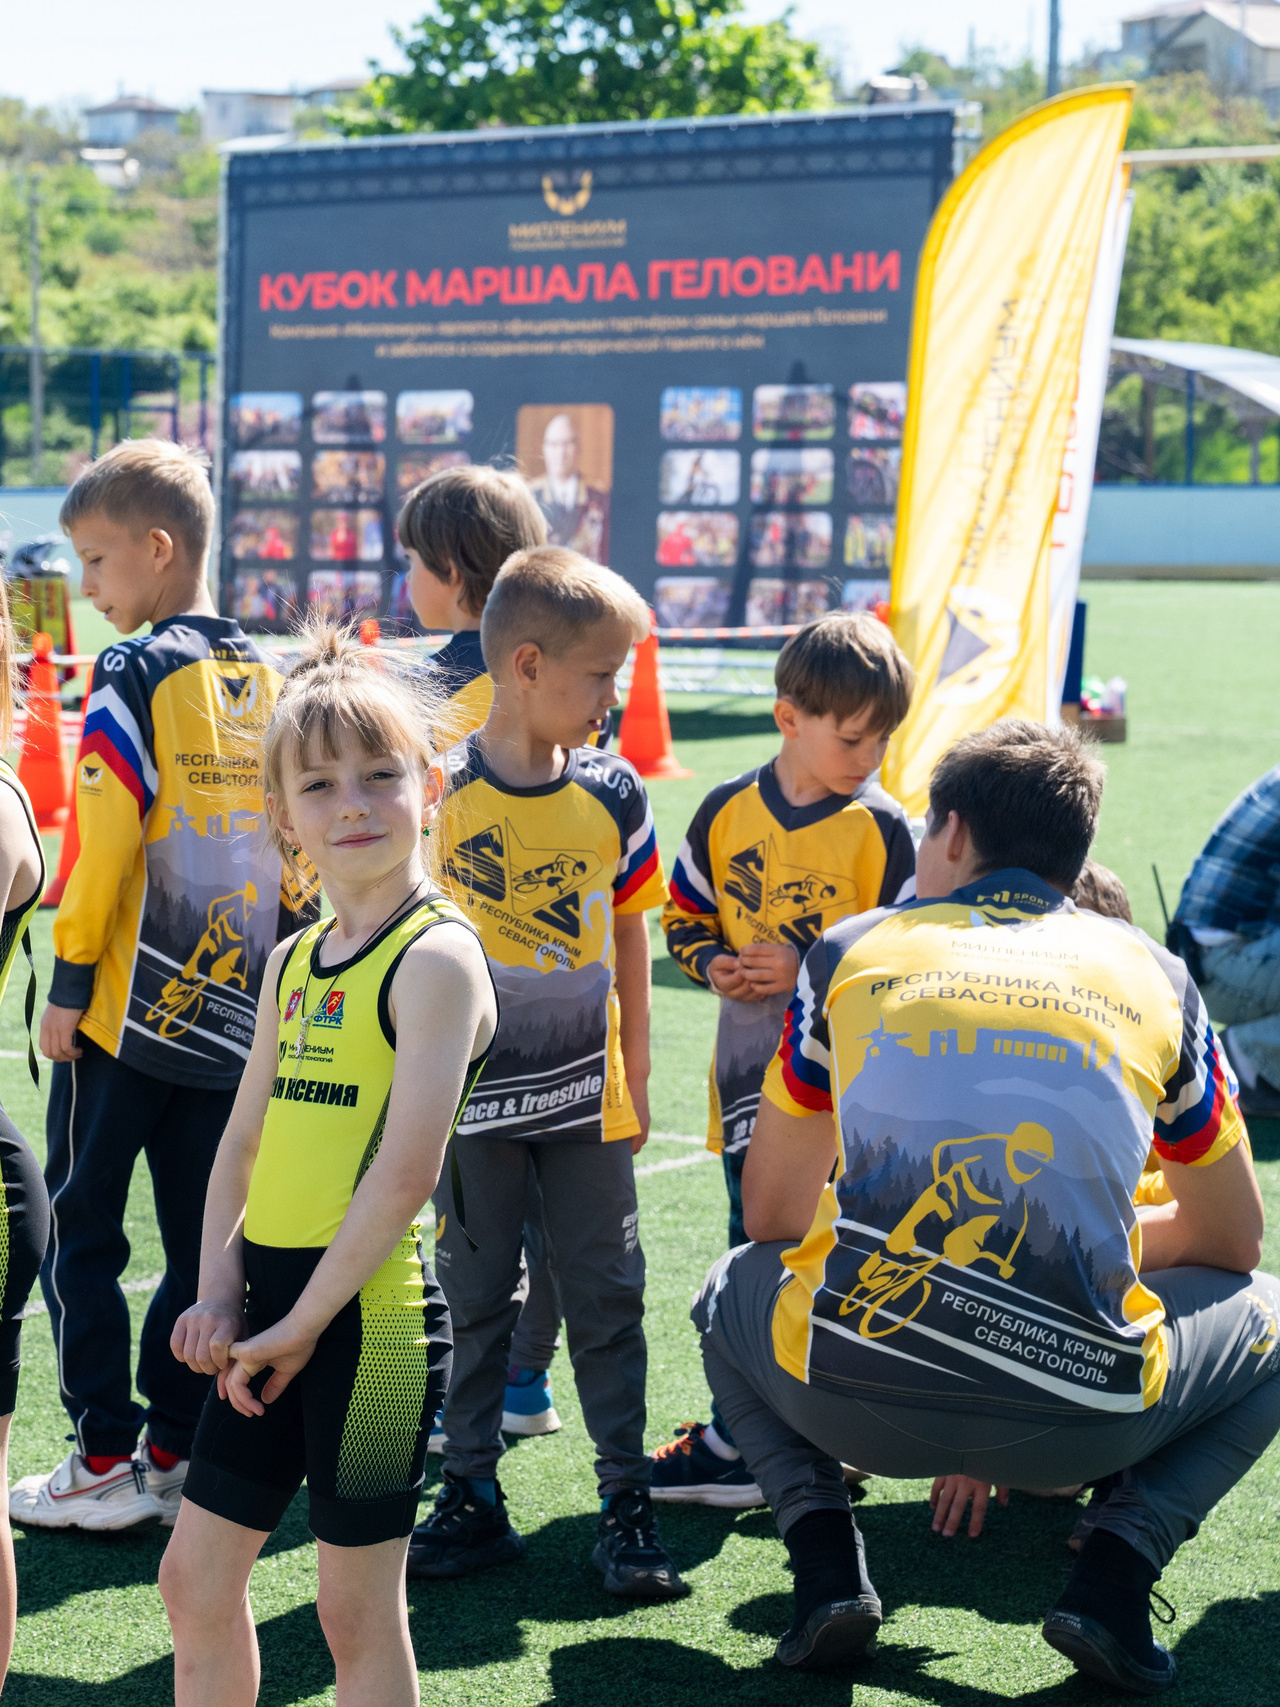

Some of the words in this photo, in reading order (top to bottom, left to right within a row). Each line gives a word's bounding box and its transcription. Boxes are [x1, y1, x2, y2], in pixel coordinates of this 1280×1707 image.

[260, 269, 399, 311] КУБОК
[406, 261, 639, 307] МАРШАЛА
[648, 250, 901, 300] ГЕЛОВАНИ
[188, 771, 263, 787] СЕВАСТОП
[585, 760, 632, 799] RUS
[1013, 893, 1050, 907] SPORT
[479, 903, 549, 942] РЕСПУБЛИКА
[552, 935, 582, 958] КРЫМ
[498, 925, 577, 970] СЕВАСТОПОЛЬ
[871, 970, 1061, 996] РЕСПУБЛИКА
[1071, 985, 1142, 1026] КРЫМ
[899, 986, 1116, 1029] СЕВАСТОПОЛЬ
[313, 1015, 343, 1025] ФТРК
[289, 1043, 334, 1055] МИЕНИУМ
[284, 1078, 359, 1107] КСЕНИЯ
[502, 1096, 517, 1116] &
[520, 1074, 602, 1114] freestyle
[941, 1291, 1058, 1349] РЕСПУБЛИКА
[1063, 1337, 1117, 1368] КРЫМ
[974, 1325, 1108, 1385] СЕВАСТОПОЛЬ
